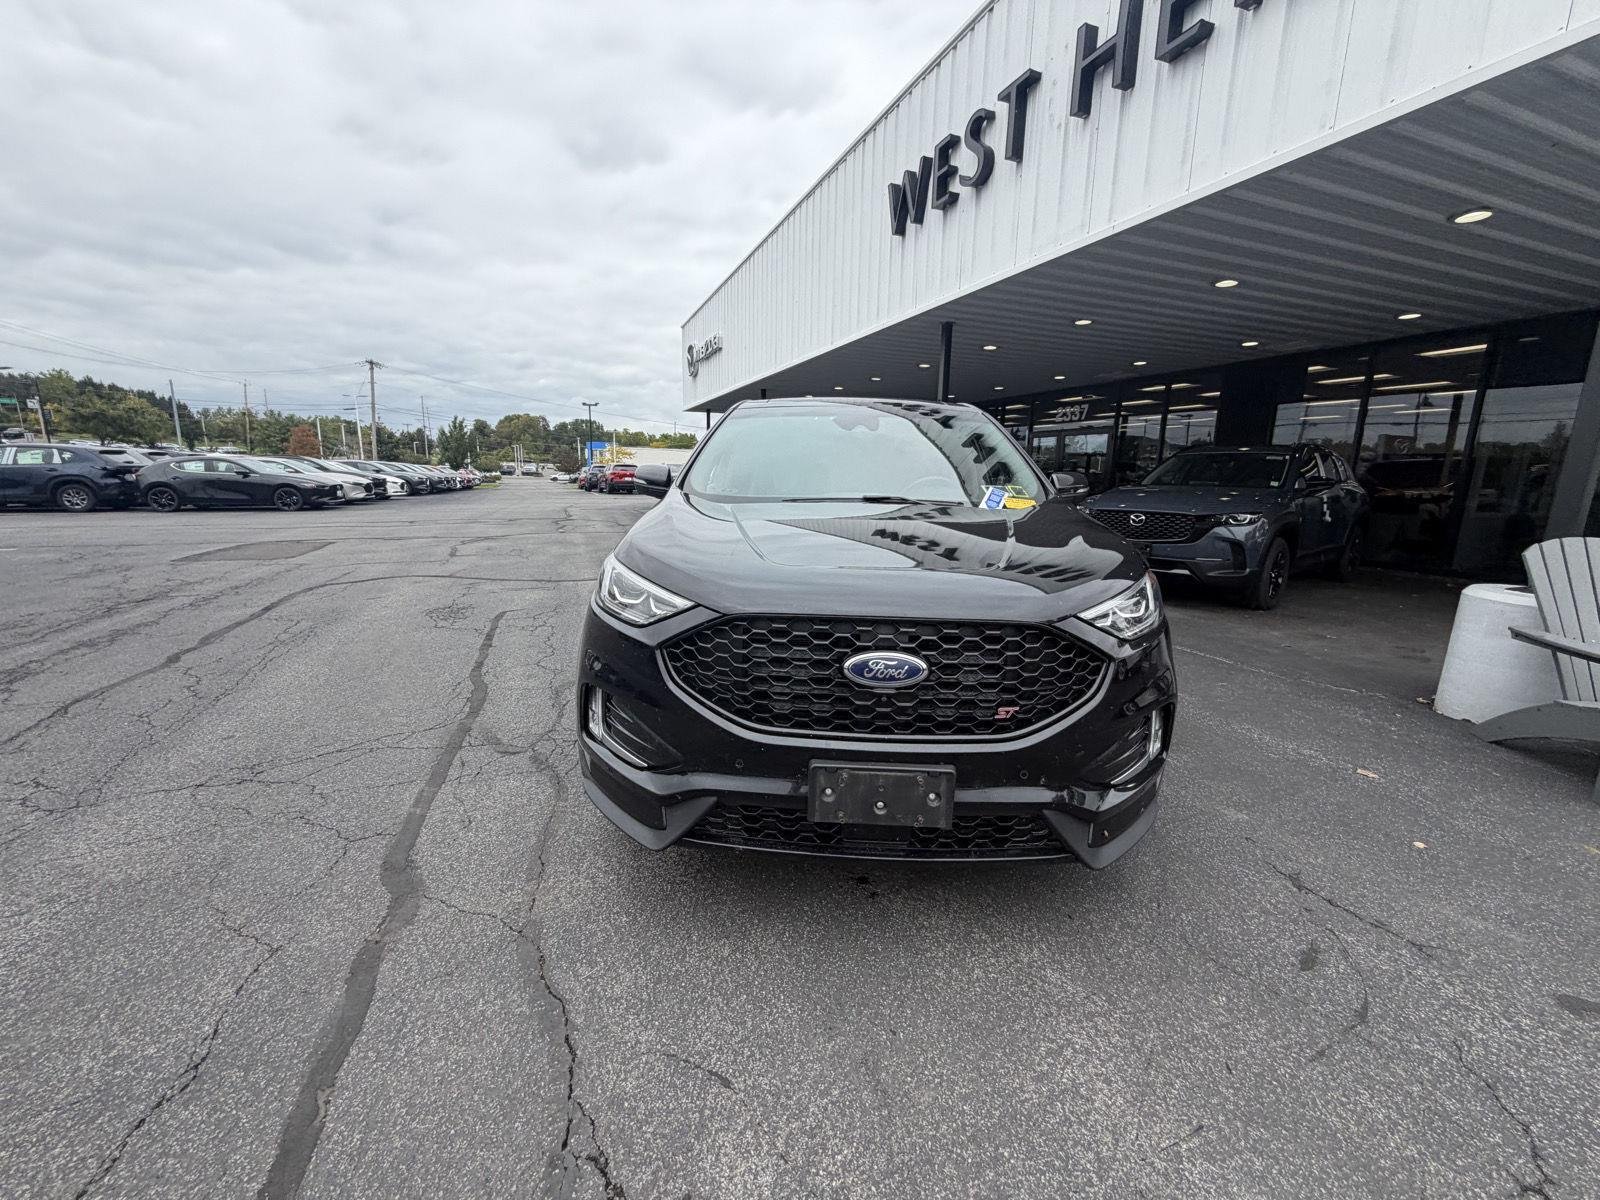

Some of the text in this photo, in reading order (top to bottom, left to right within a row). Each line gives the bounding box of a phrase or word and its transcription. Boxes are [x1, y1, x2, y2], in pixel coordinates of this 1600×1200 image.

[888, 68, 1042, 236] WEST
[1056, 404, 1088, 422] 2337
[863, 659, 908, 680] Ford
[994, 706, 1020, 719] ST
